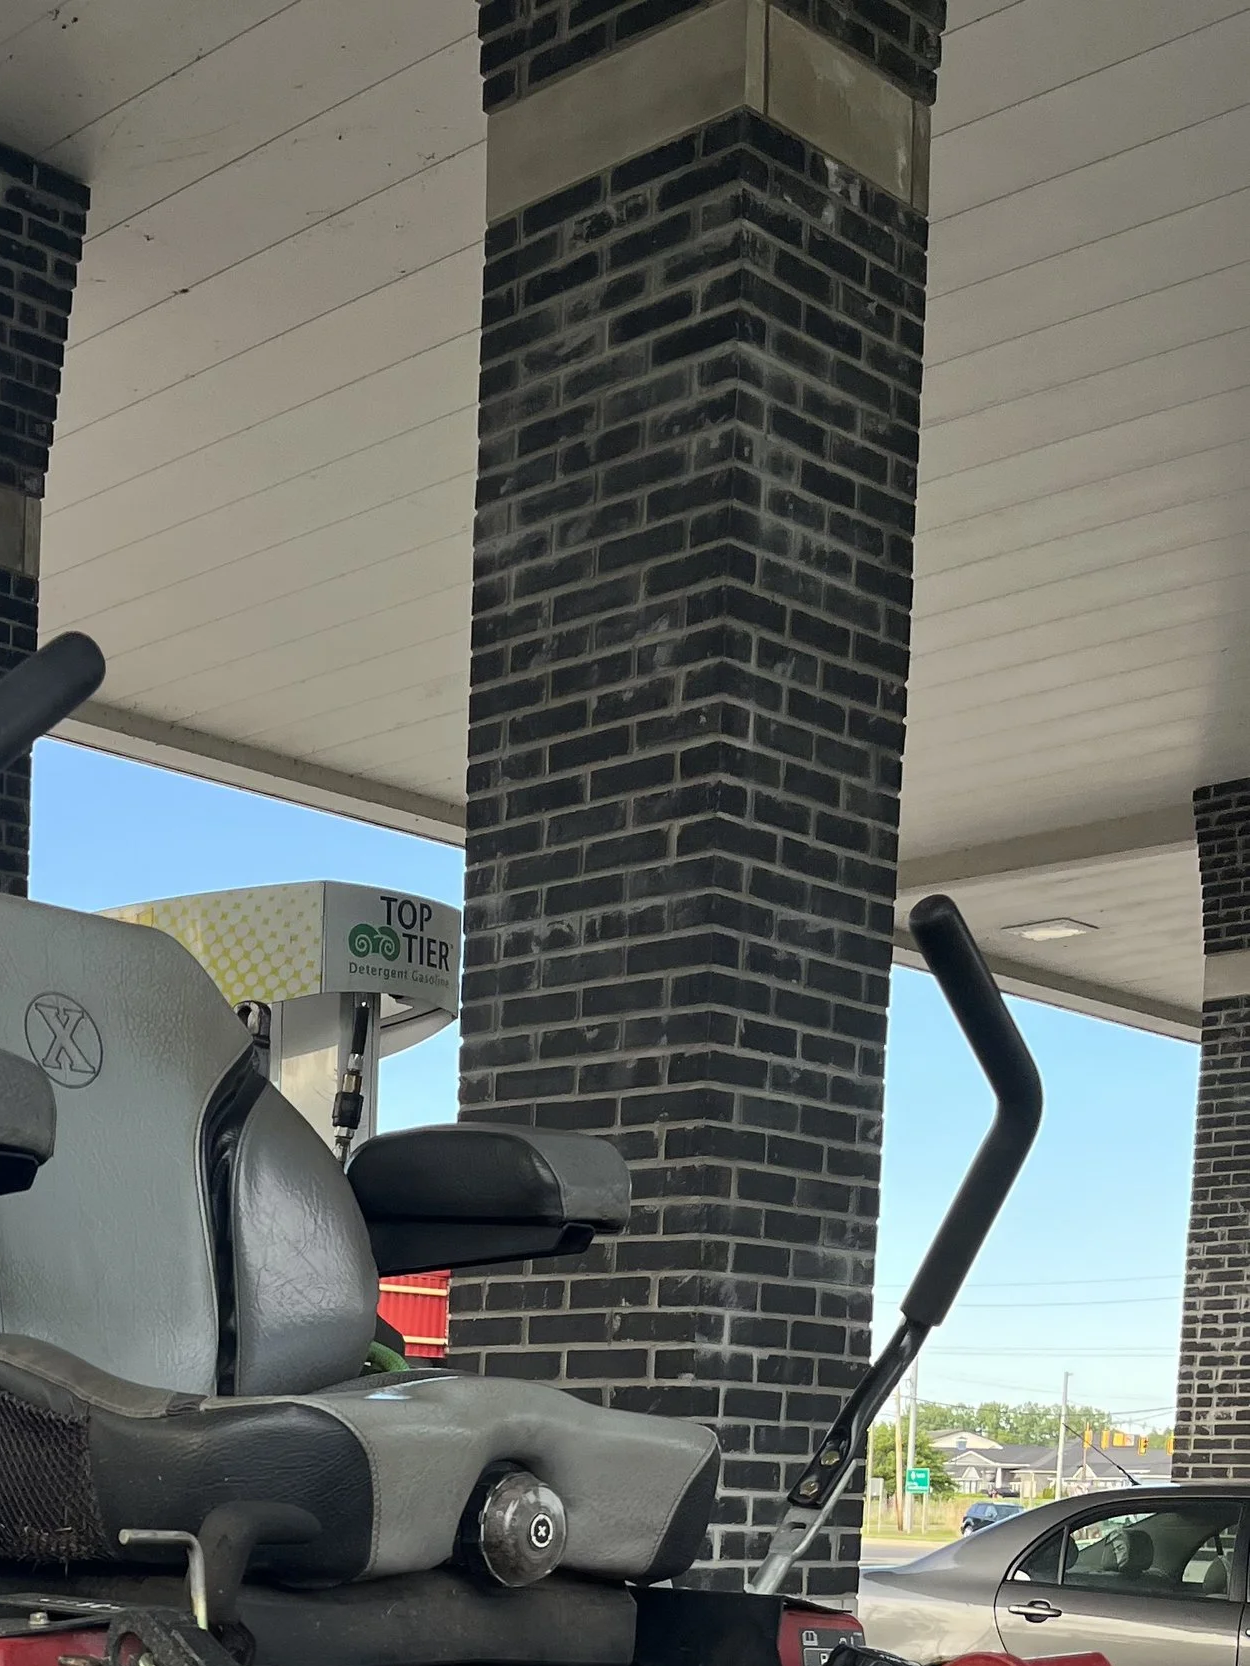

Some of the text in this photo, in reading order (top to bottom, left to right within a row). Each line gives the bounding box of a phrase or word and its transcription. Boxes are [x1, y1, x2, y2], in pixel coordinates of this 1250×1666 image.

[380, 896, 432, 931] TOP
[403, 933, 450, 971] TIER
[349, 962, 450, 987] Detergent Gasoline
